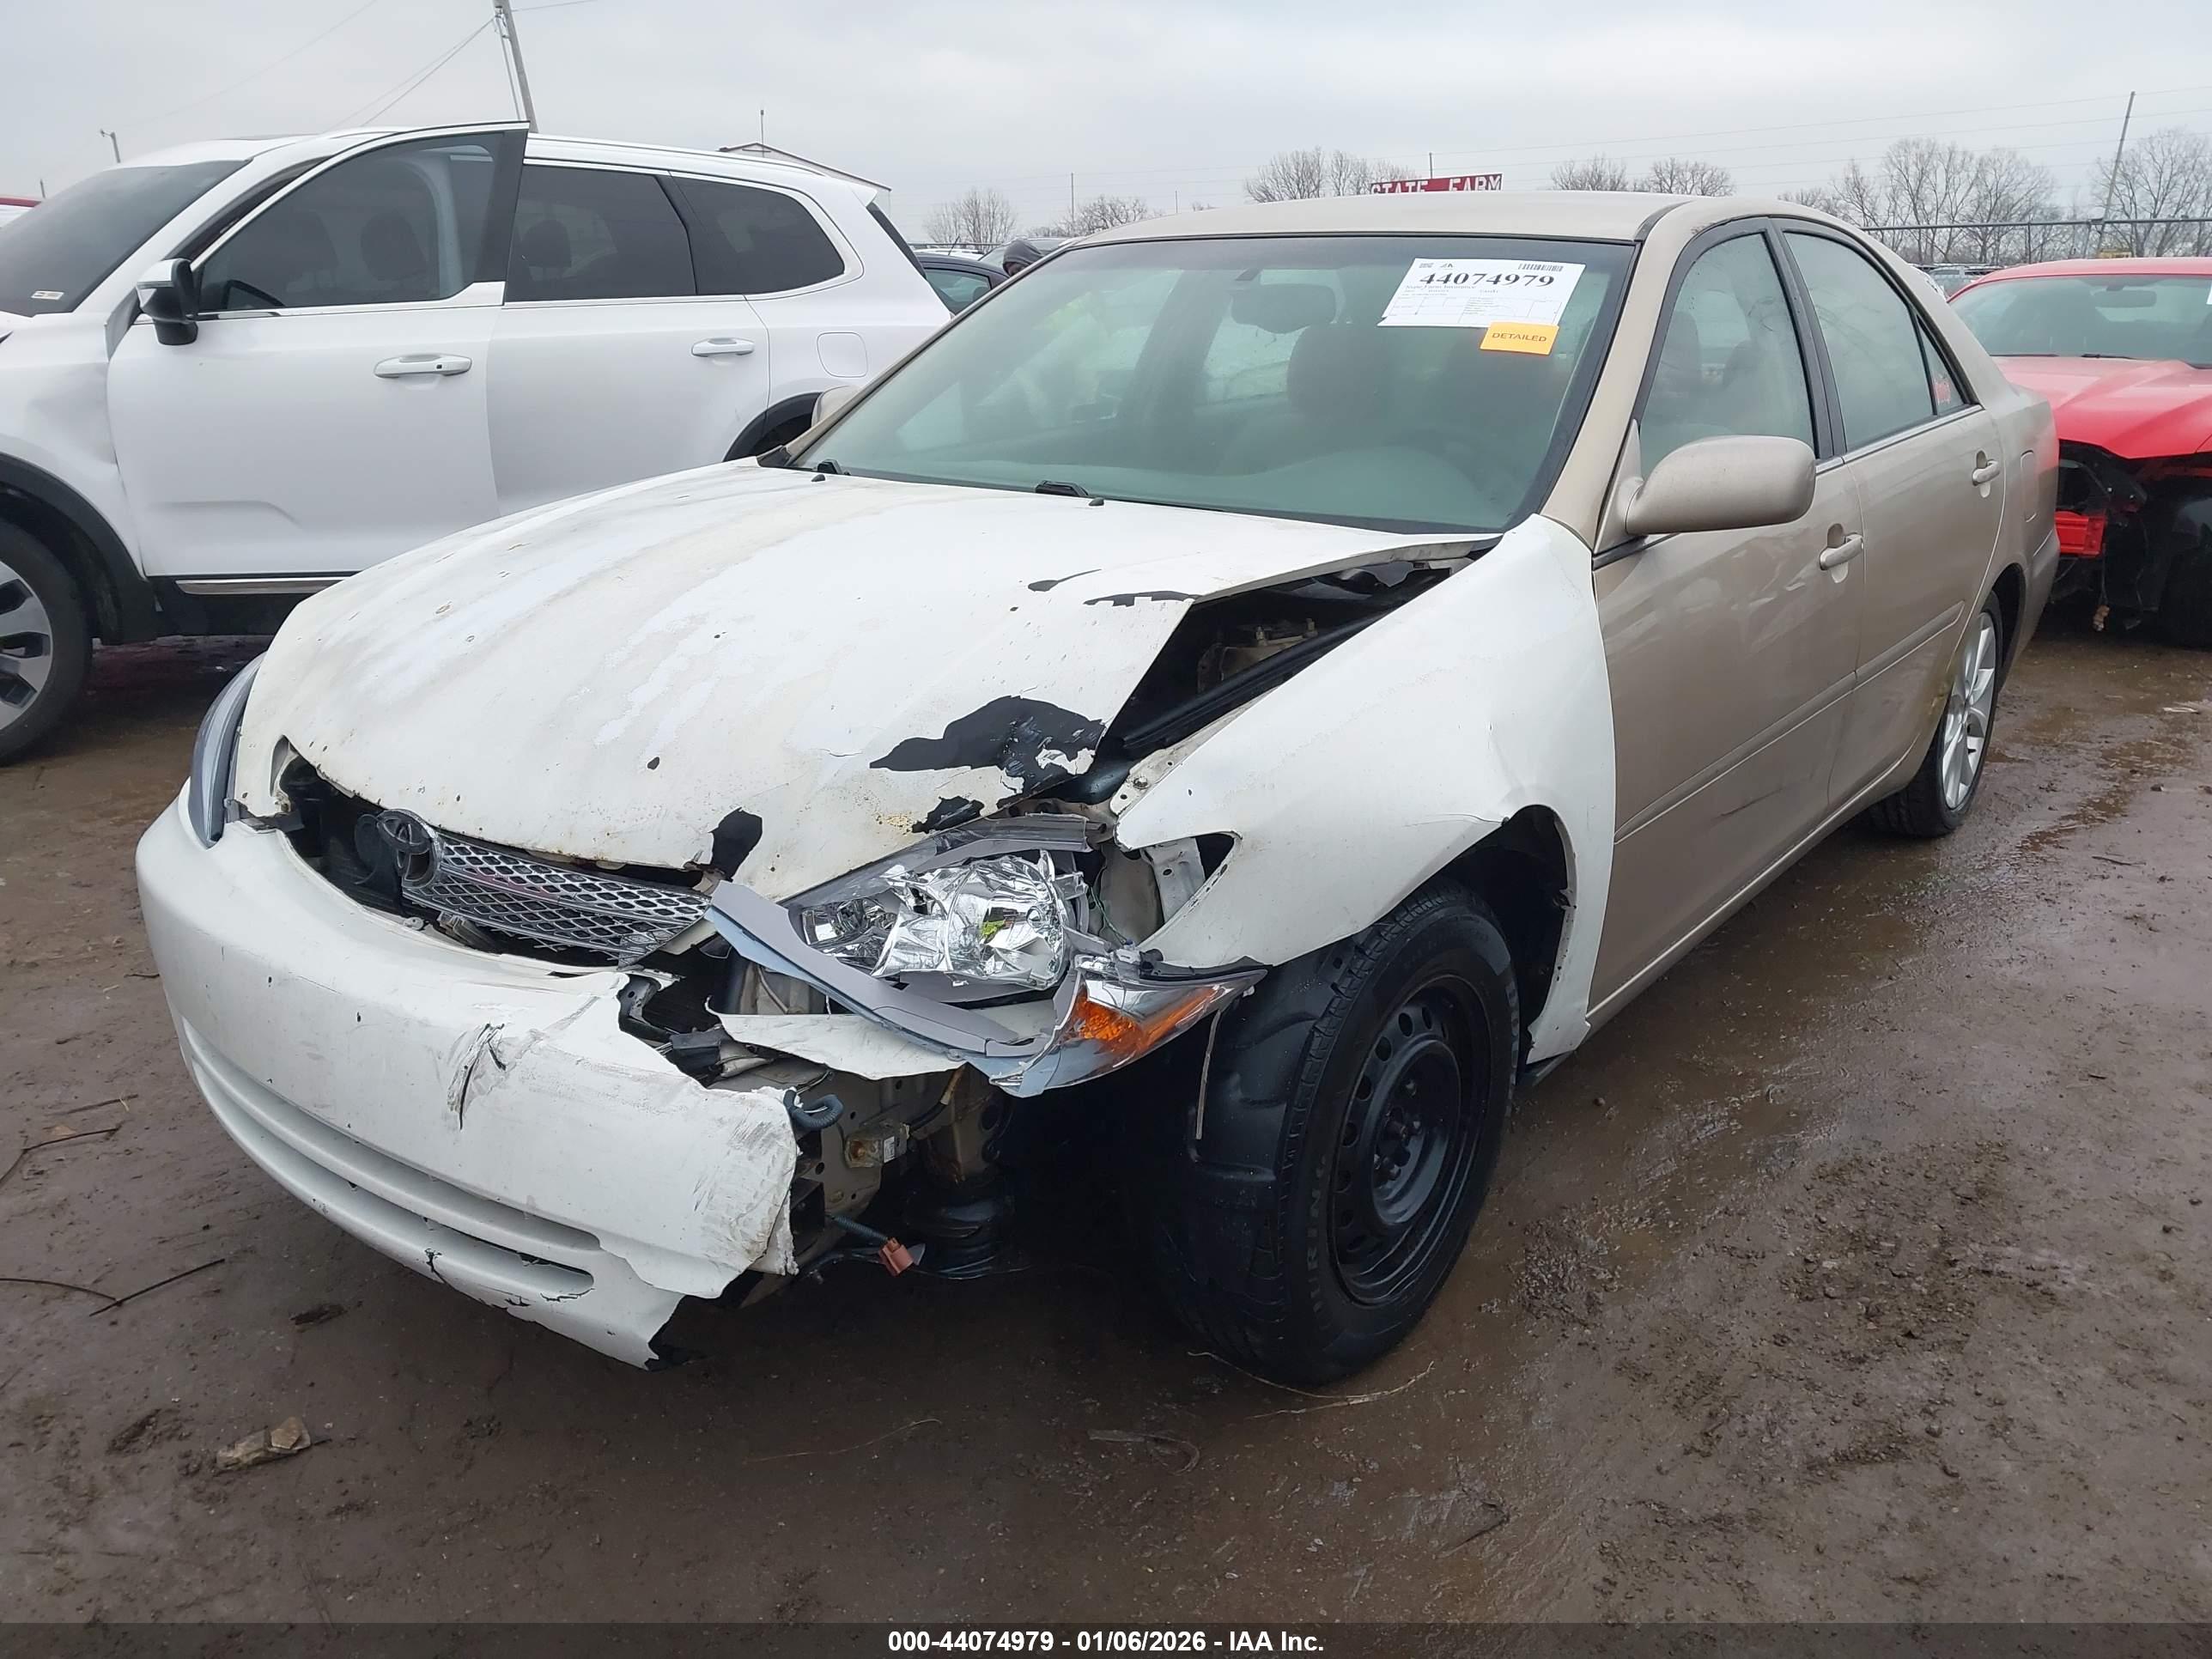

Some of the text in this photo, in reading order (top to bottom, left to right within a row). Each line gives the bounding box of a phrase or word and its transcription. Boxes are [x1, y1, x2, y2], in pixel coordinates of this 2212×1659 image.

[1371, 175, 1501, 194] STATE FARM
[1419, 272, 1555, 287] 44074979
[1492, 331, 1547, 343] DETAILED
